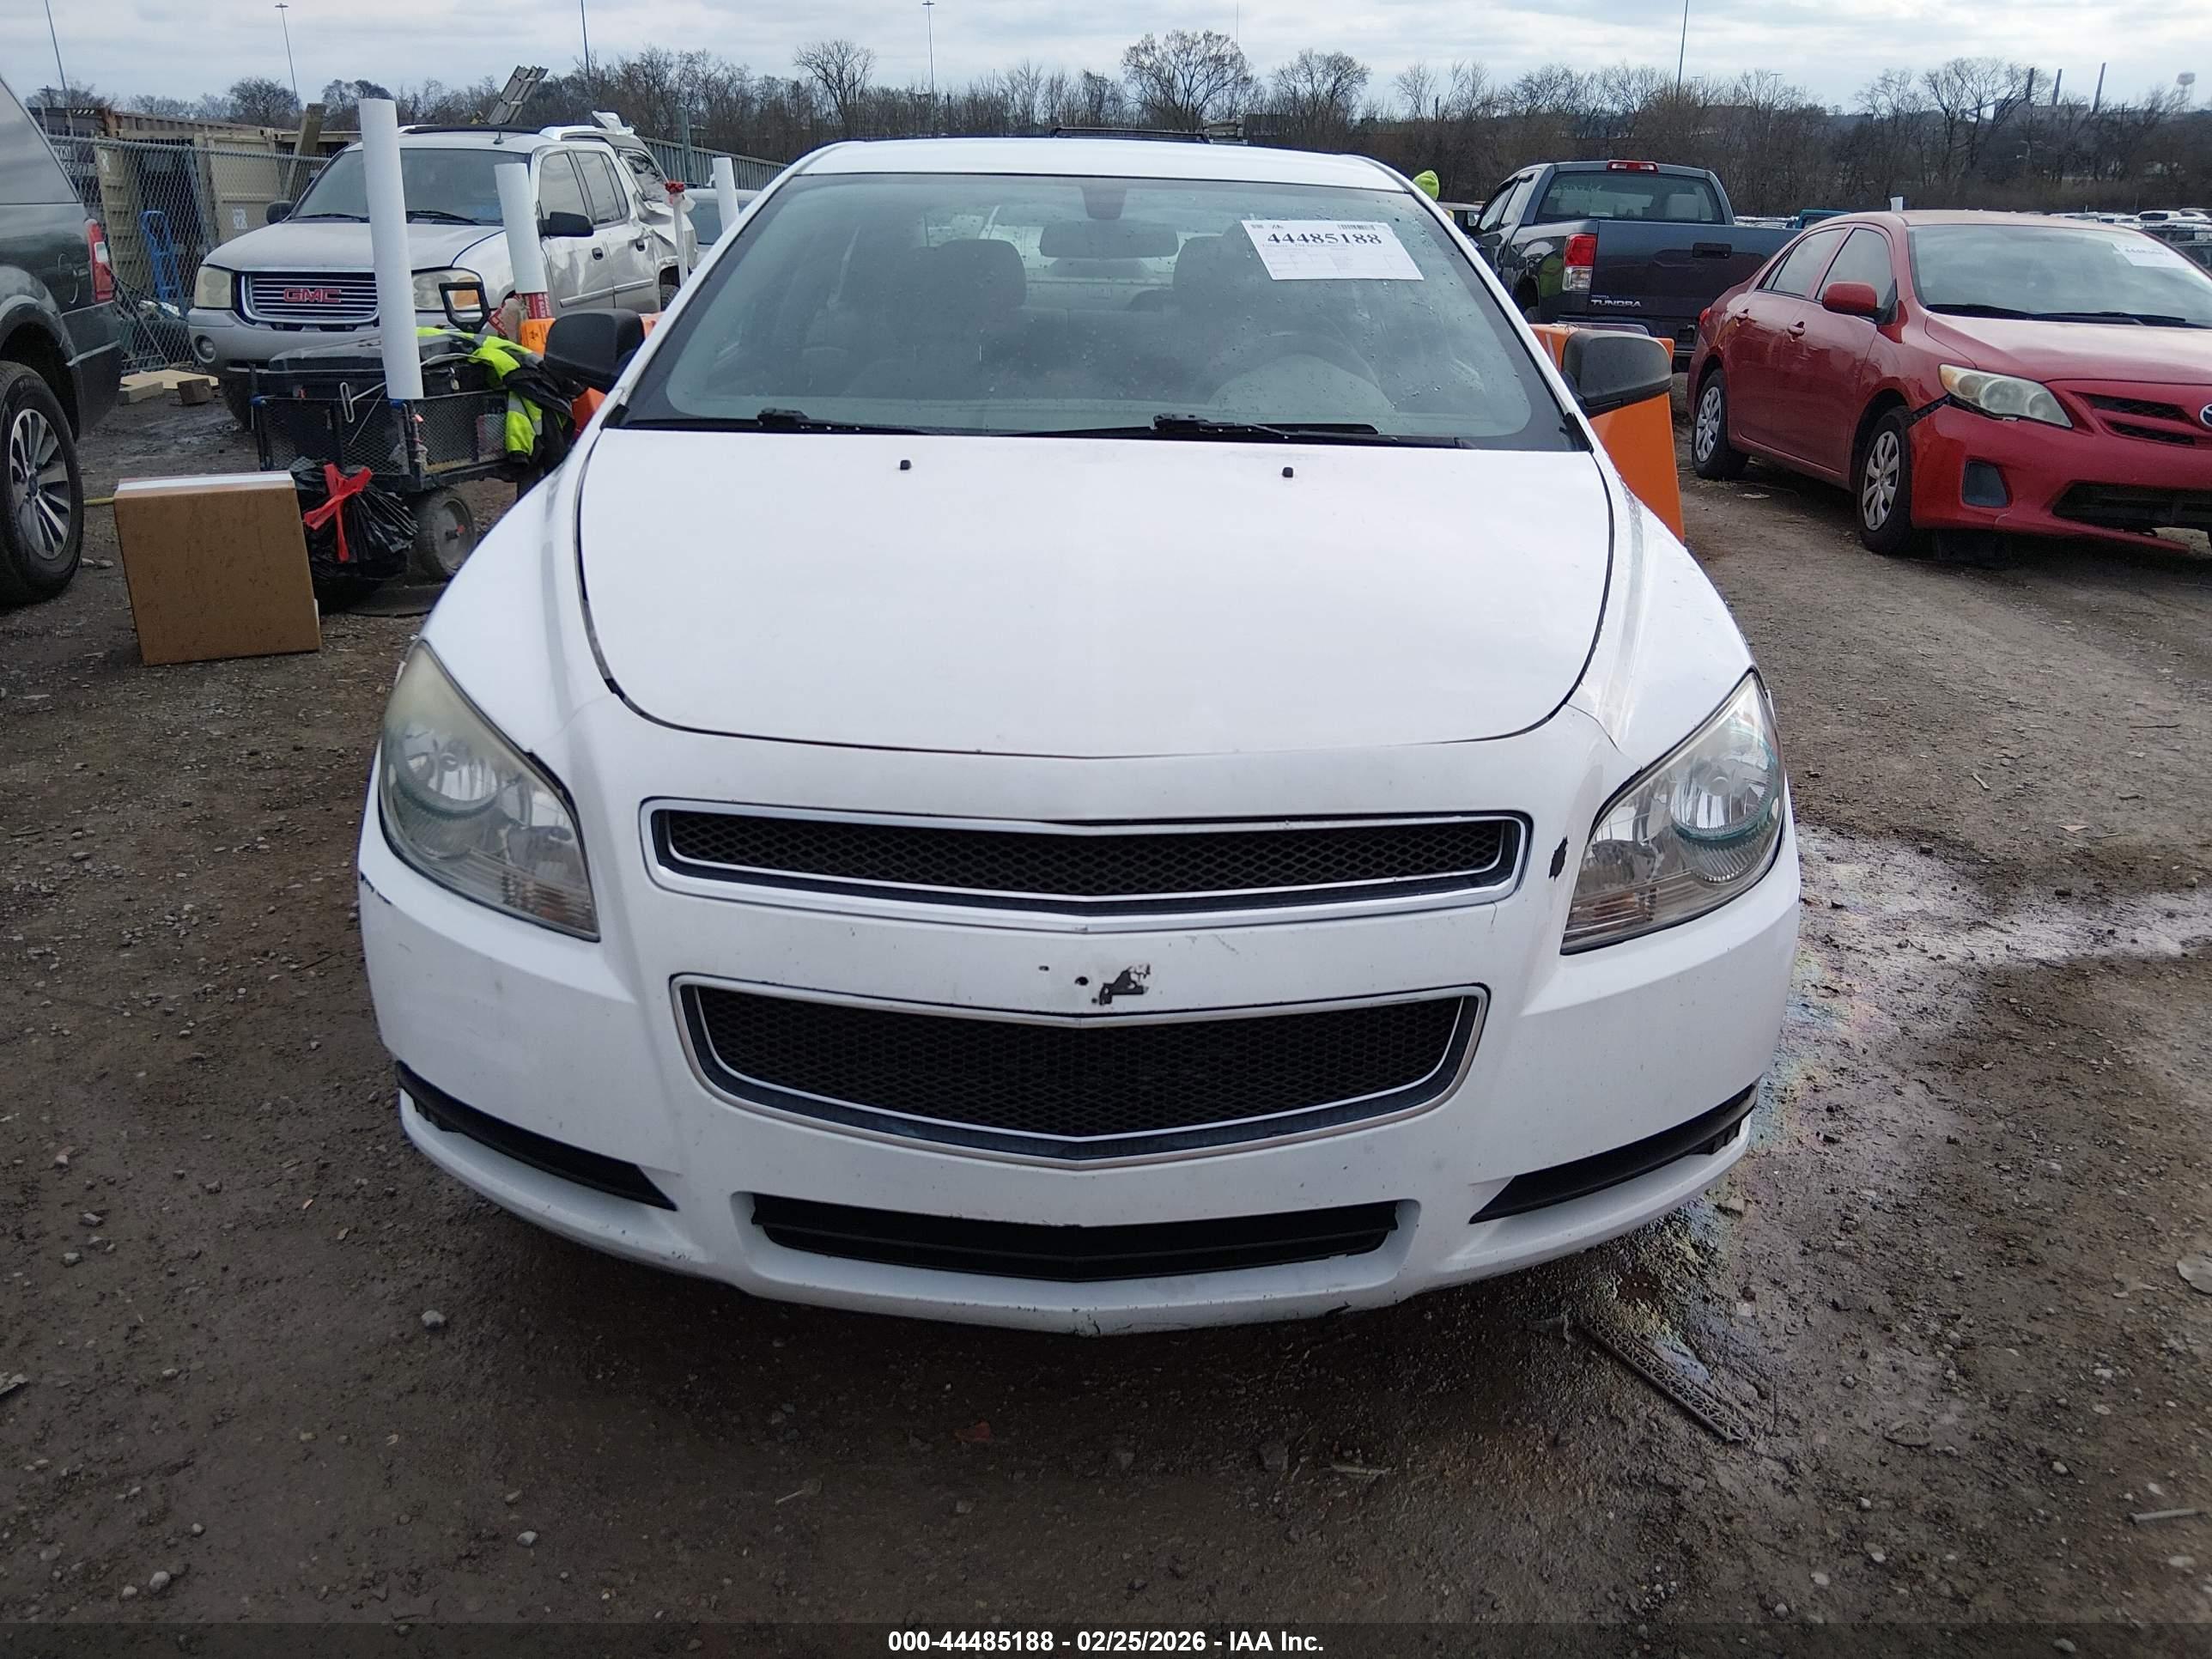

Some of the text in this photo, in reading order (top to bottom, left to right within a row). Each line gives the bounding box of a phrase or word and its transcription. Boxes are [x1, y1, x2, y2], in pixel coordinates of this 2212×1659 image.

[1267, 233, 1382, 245] 44485188
[283, 288, 342, 303] GMC
[1590, 299, 1642, 307] TUNDRA
